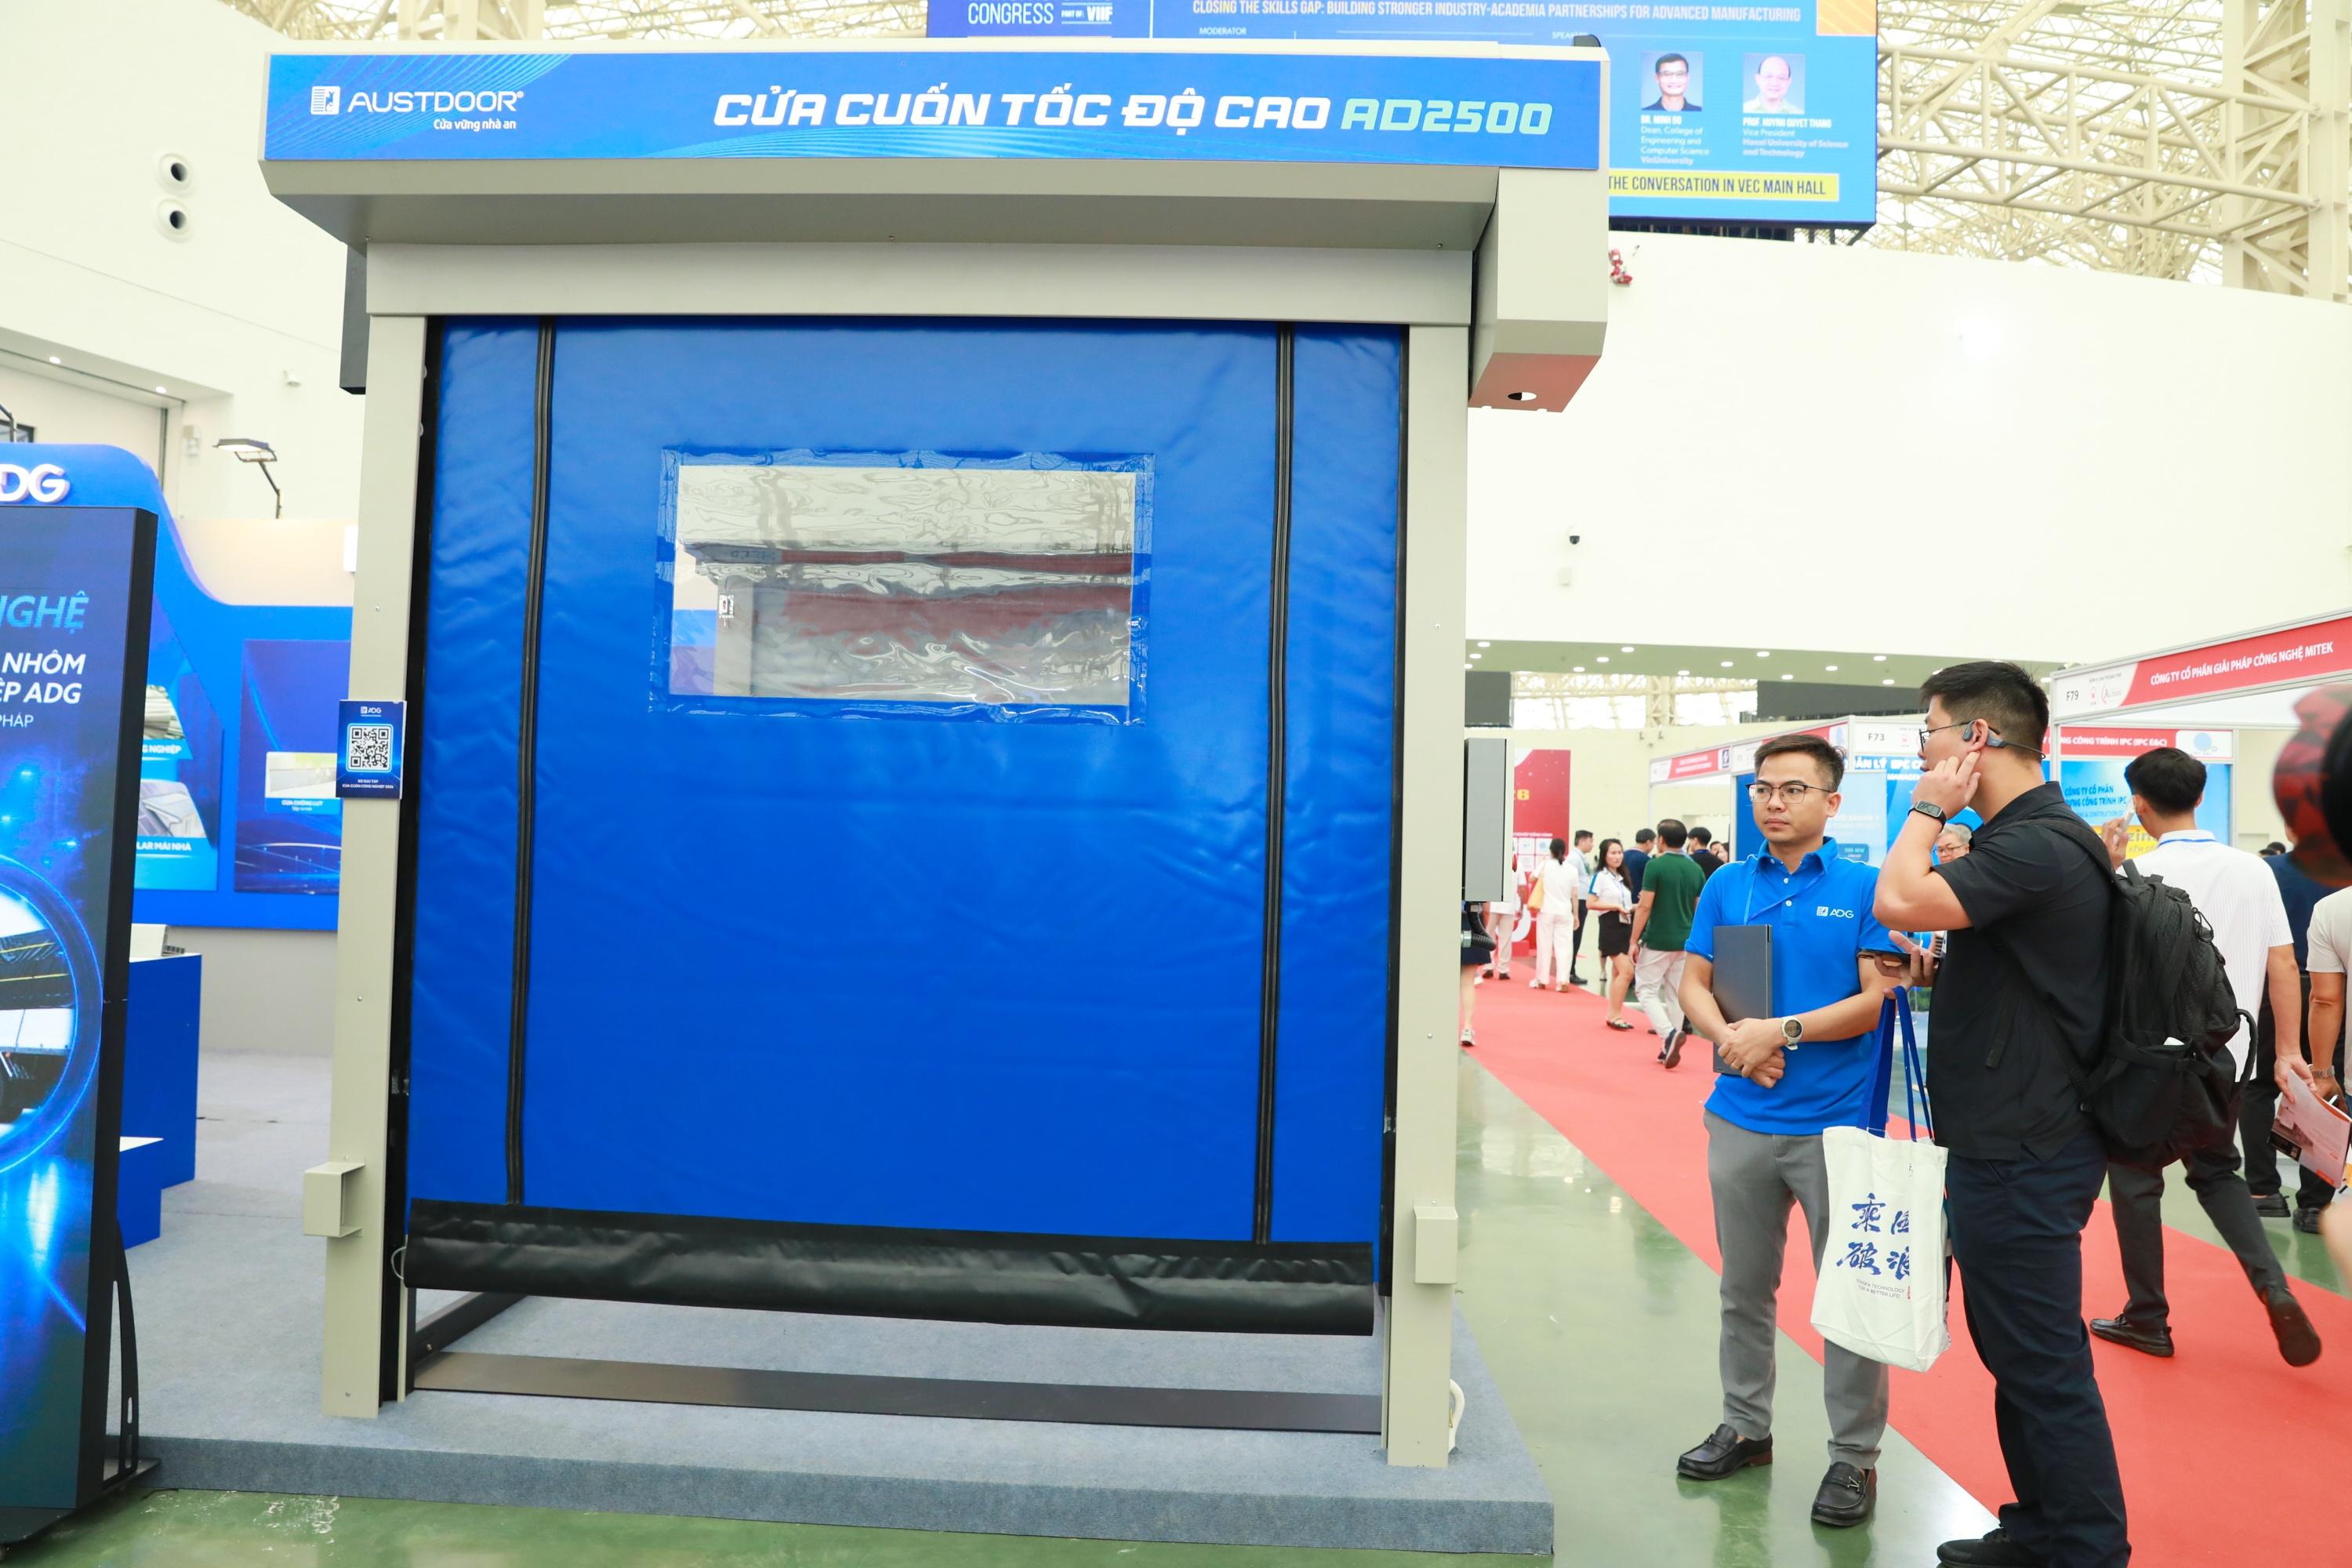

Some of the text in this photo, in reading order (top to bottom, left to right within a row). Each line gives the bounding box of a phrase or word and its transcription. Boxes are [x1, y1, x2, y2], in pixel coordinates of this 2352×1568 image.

[967, 2, 1054, 24] CONGRESS
[1192, 0, 1802, 22] CLOSING THE SKILLS GAP: BUILDING STRONGER INDUSTRY-ACADEMIA PARTNERSHIPS FOR ADVANCED MANUFACTURING
[1199, 27, 1247, 36] MODERATOR
[713, 82, 1553, 136] CỬA CUỐN TỐC ĐỘ CAO AD2500
[434, 118, 517, 132] Cửa vững nhà an
[1641, 136, 1686, 146] Engineering
[1641, 146, 1710, 156] Computer Science
[1608, 176, 1826, 195] THE CONVERSATION IN VEC MAIN HALL
[0, 590, 89, 634] GHỆ
[2, 648, 87, 675] NHÔM
[2150, 674, 2171, 686] CÔNG
[2171, 671, 2181, 682] TY
[2230, 655, 2252, 671] PHÁP
[2253, 652, 2278, 667] CÔNG
[2278, 645, 2303, 662] NGHỆ
[2304, 641, 2334, 657] MITEK
[23, 681, 82, 705] ADG
[2065, 691, 2079, 702] F79
[1867, 732, 1885, 742] F73
[2072, 735, 2095, 745] CÔNG
[1829, 908, 1854, 919] ADG
[1871, 1283, 1905, 1294] TECHNOLOGY
